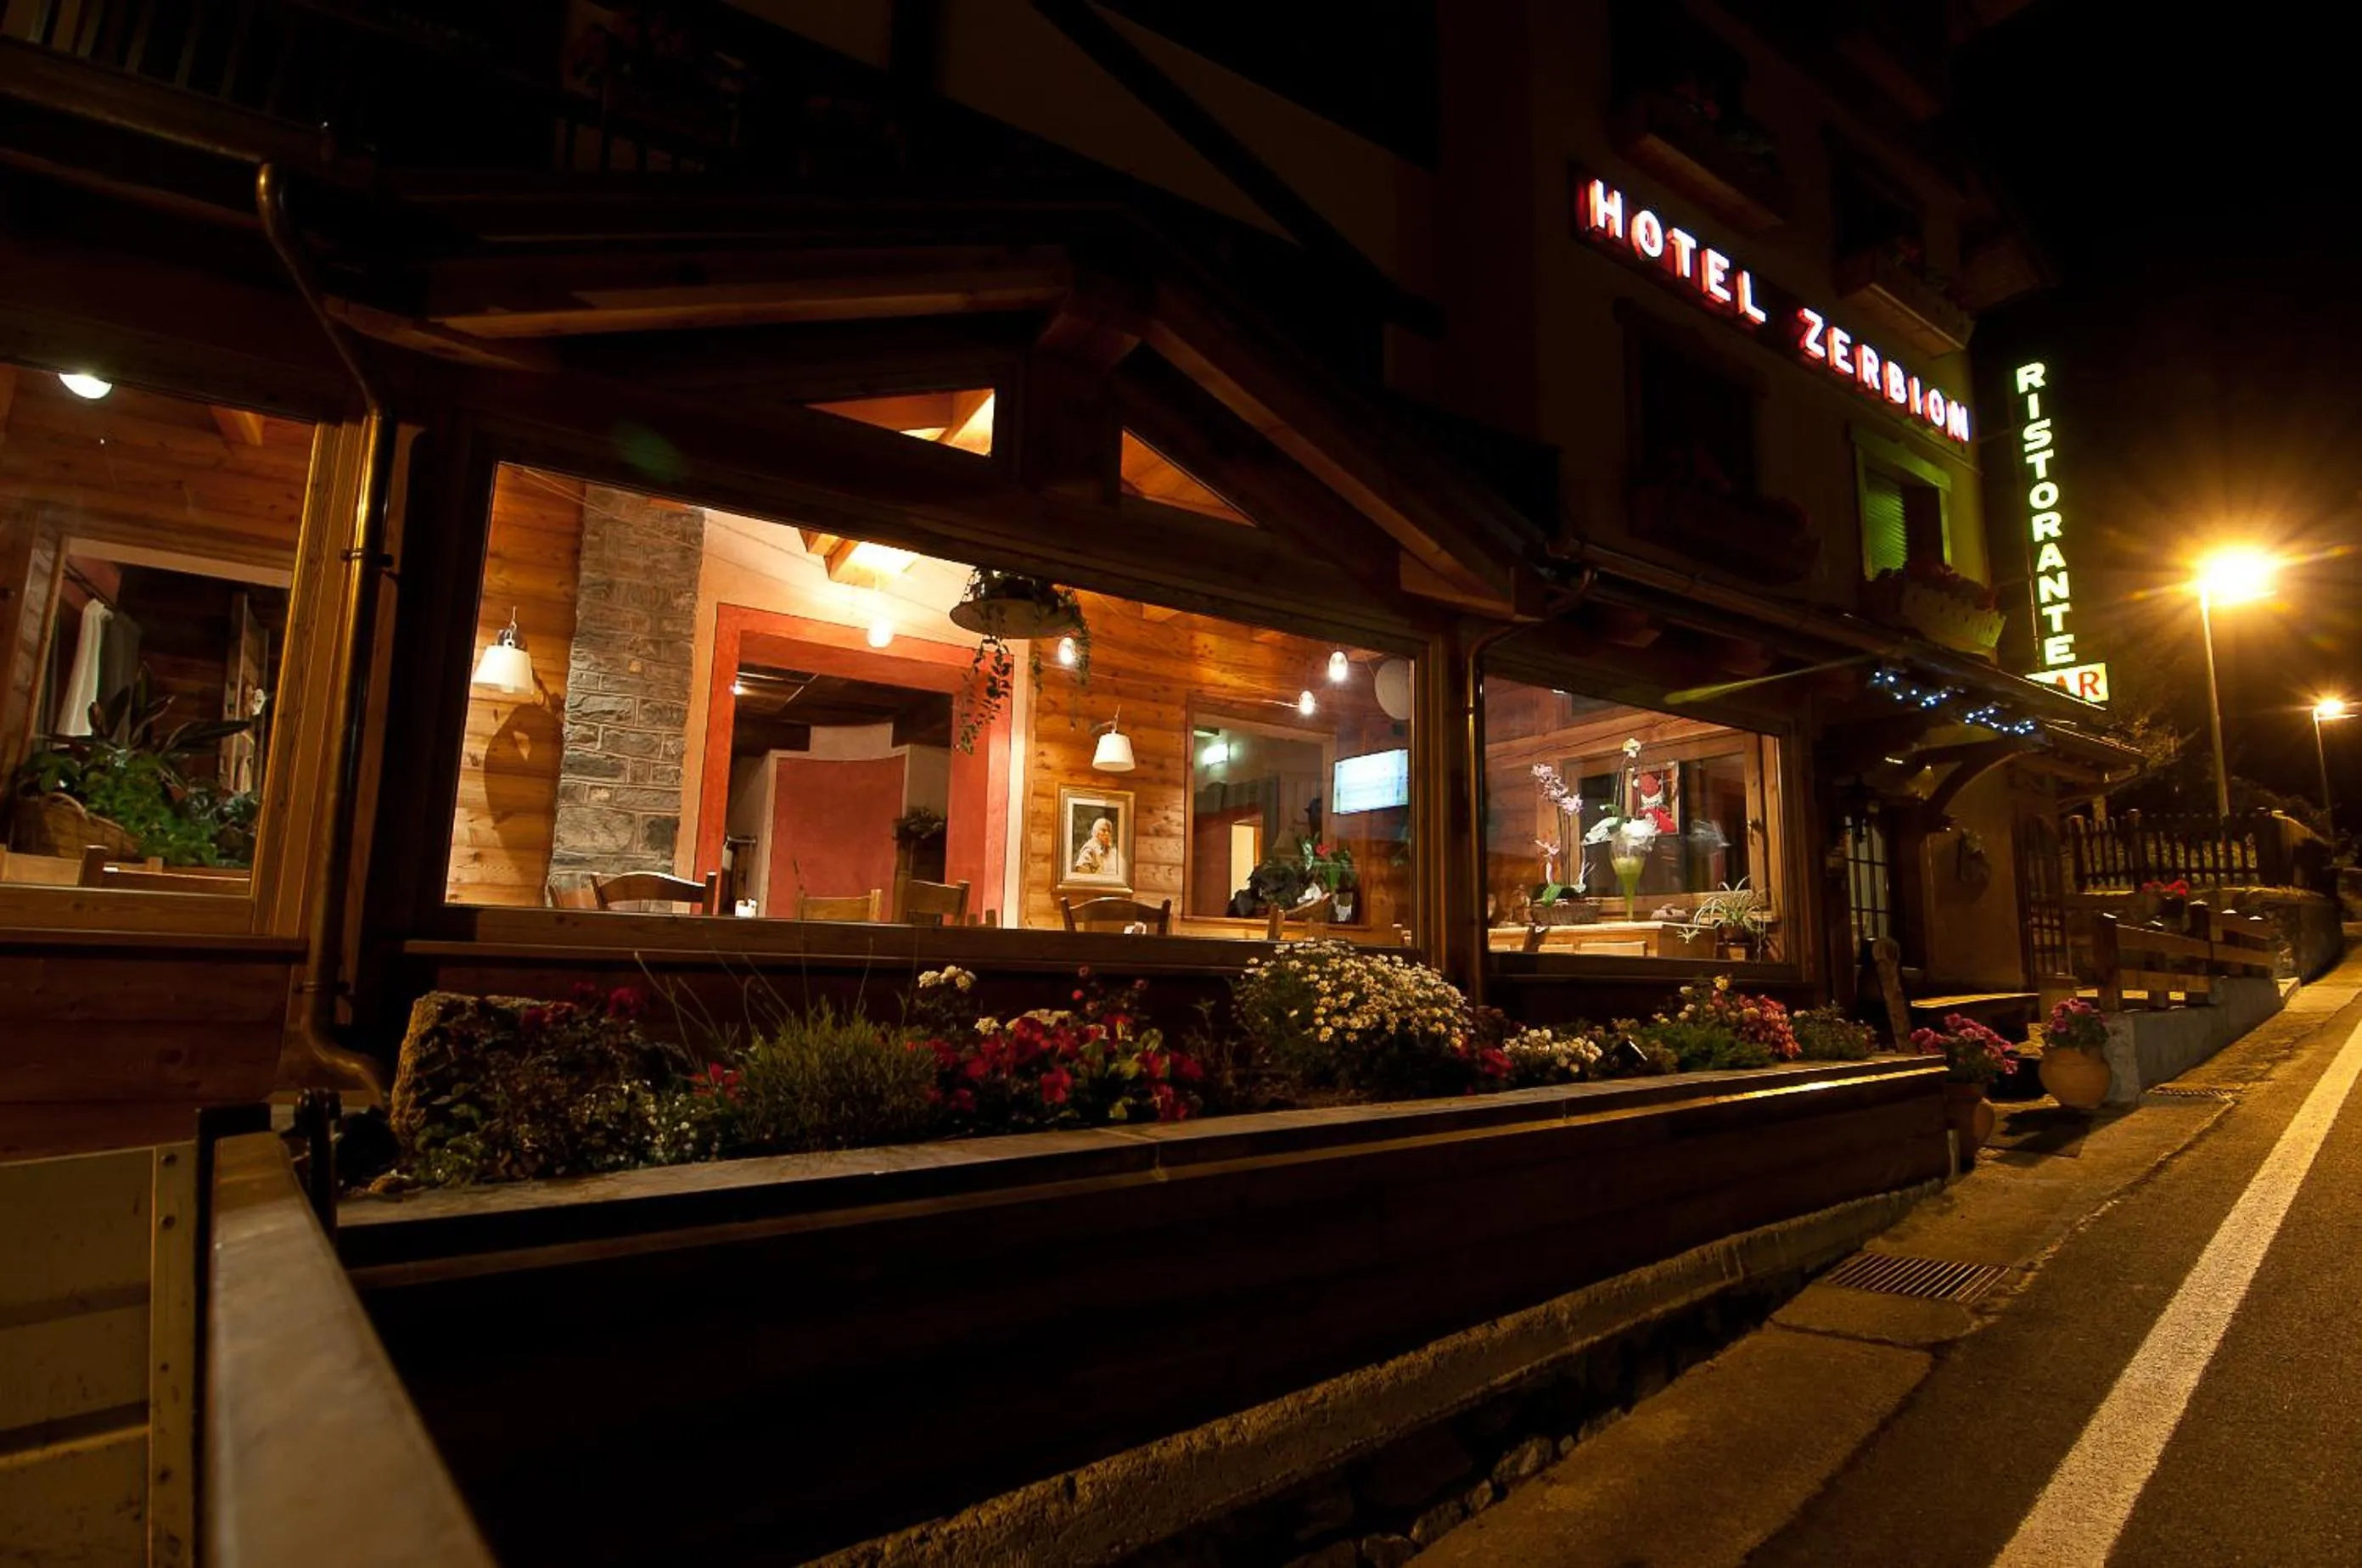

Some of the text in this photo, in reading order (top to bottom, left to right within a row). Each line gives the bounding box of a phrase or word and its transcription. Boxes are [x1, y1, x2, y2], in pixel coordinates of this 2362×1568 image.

[1588, 177, 1970, 443] HOTEL ZERBION
[2016, 361, 2077, 666] RISTORANTE
